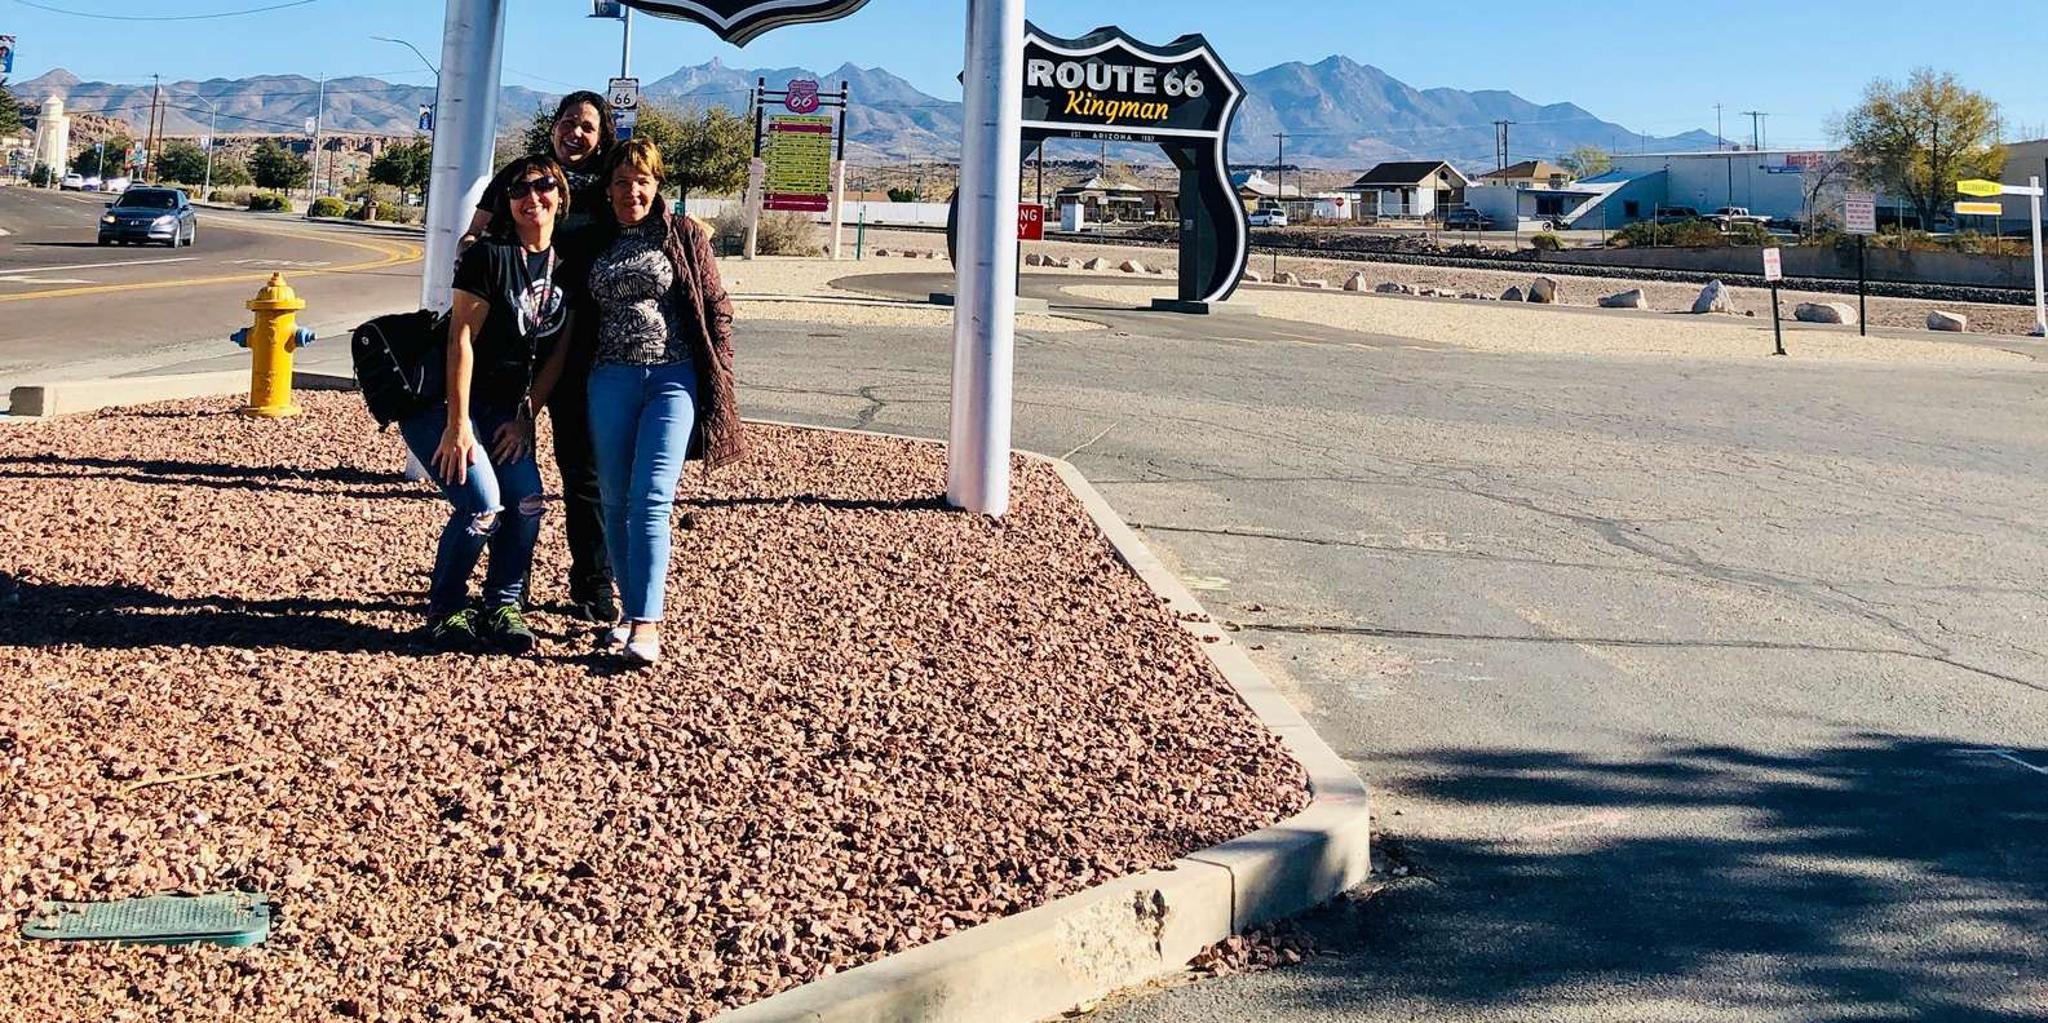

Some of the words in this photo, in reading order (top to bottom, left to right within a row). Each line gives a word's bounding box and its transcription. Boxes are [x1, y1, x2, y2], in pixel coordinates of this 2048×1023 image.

[1027, 58, 1157, 95] ROUTE
[1163, 68, 1204, 98] 66
[614, 93, 631, 105] 66
[1064, 90, 1170, 124] Kingman
[1092, 132, 1133, 141] ARIZONA
